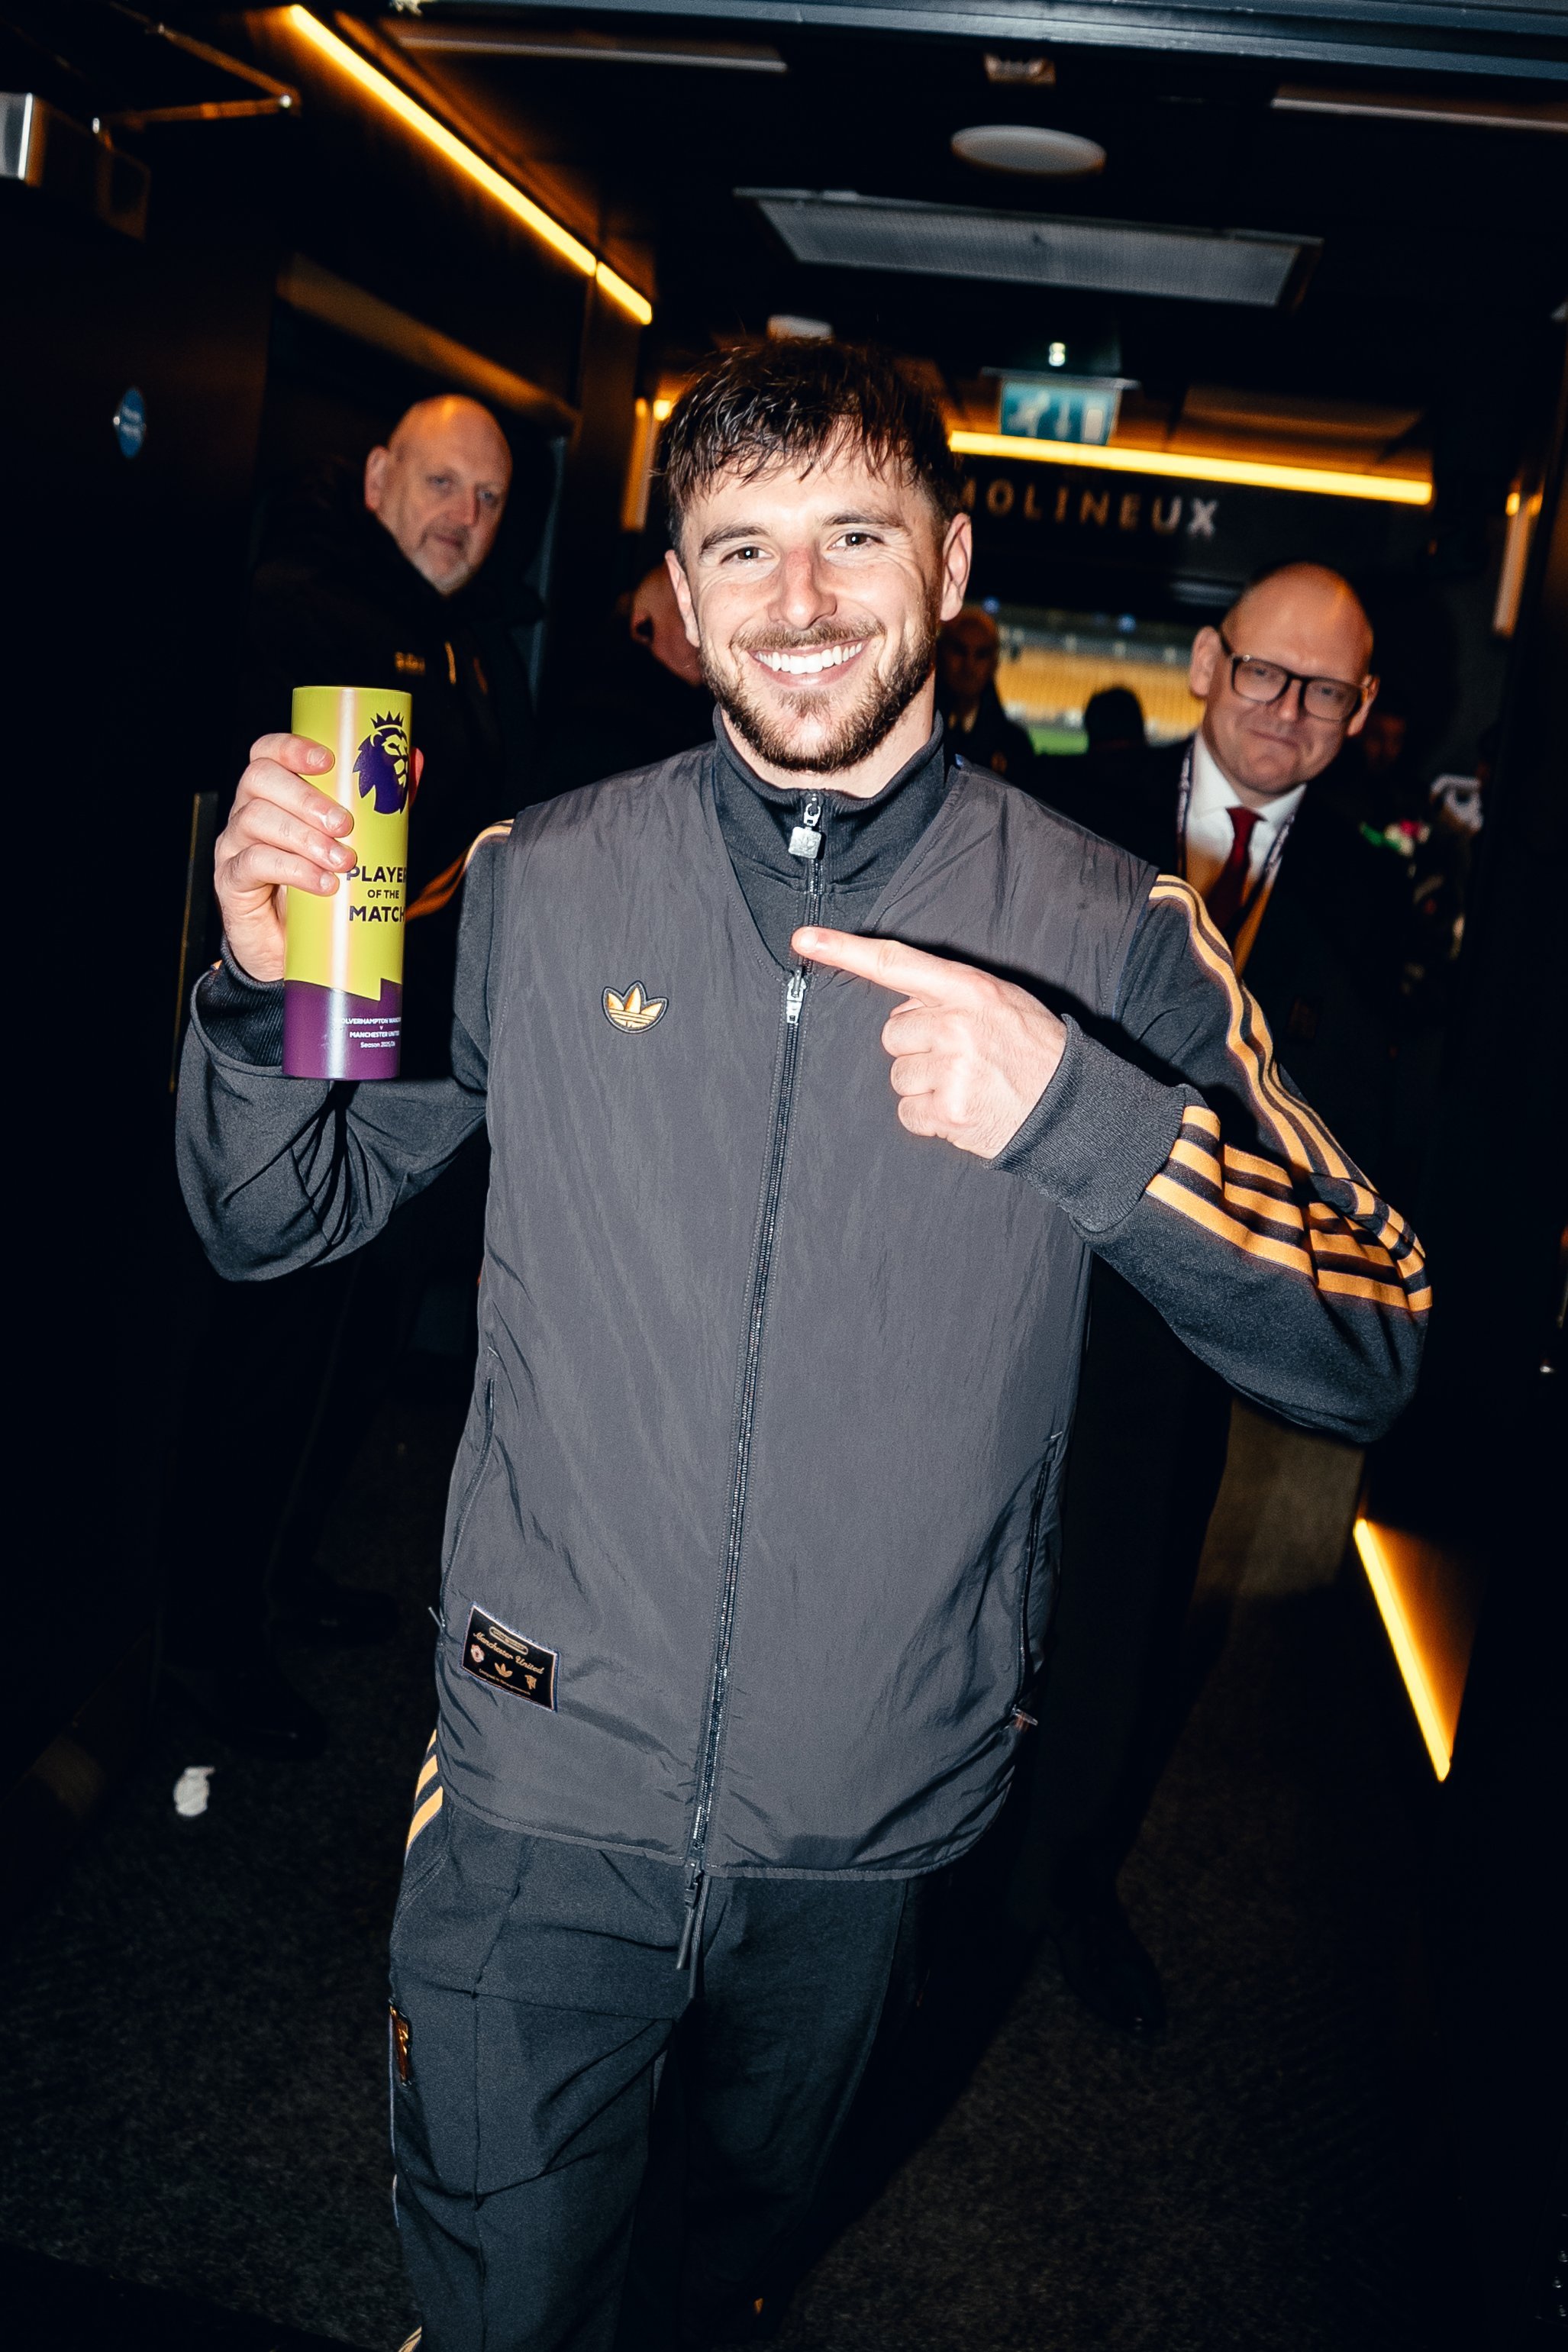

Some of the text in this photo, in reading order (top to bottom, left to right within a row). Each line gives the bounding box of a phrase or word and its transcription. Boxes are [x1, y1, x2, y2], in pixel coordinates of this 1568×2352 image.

[367, 889, 399, 899] OF THE
[349, 905, 405, 922] MATCH
[515, 1655, 545, 1674] United
